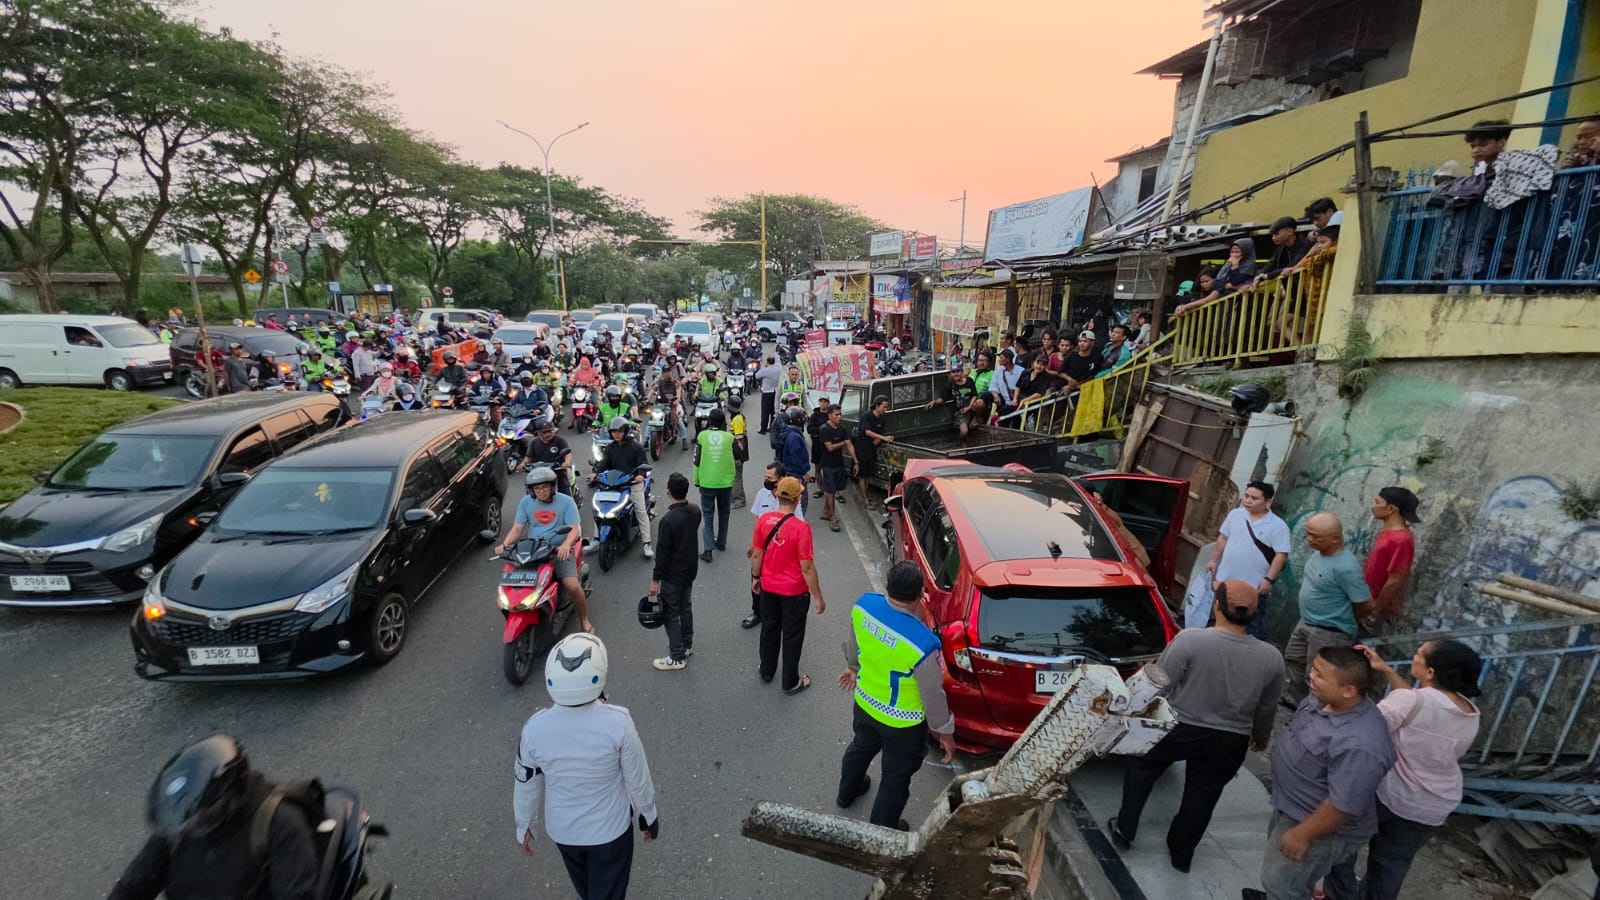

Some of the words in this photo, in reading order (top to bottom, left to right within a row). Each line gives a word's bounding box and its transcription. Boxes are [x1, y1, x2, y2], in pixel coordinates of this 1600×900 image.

[11, 577, 18, 586] B
[863, 618, 898, 649] POLISI
[190, 650, 198, 660] B
[1038, 673, 1046, 685] B
[1052, 672, 1073, 685] 26
